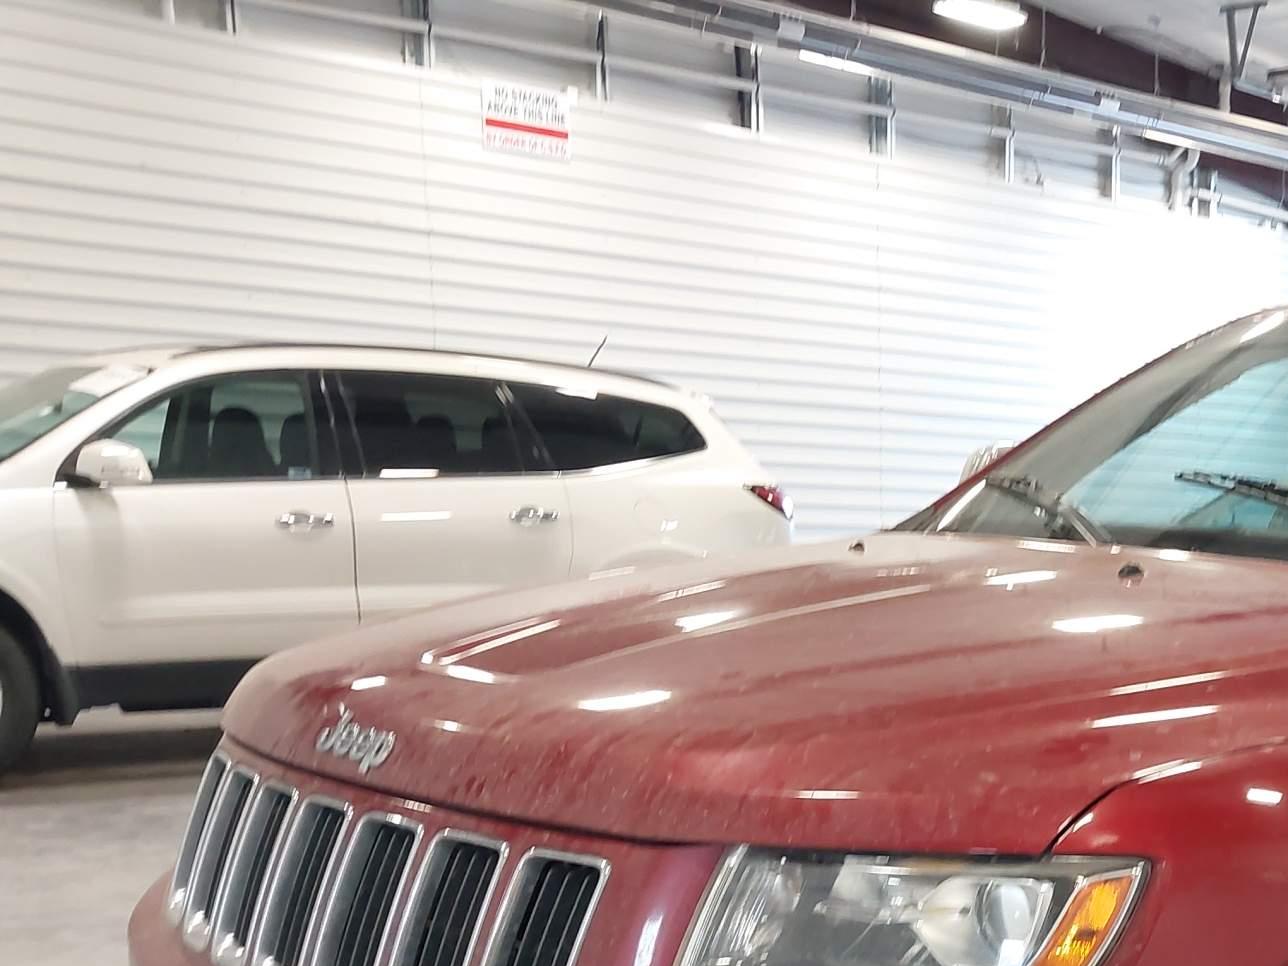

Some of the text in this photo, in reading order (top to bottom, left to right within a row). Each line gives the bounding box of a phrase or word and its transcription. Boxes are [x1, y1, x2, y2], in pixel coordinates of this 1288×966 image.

[511, 87, 558, 108] STACKING
[487, 101, 518, 116] ABOVE
[523, 106, 543, 122] THIS
[315, 701, 397, 775] Jeep
